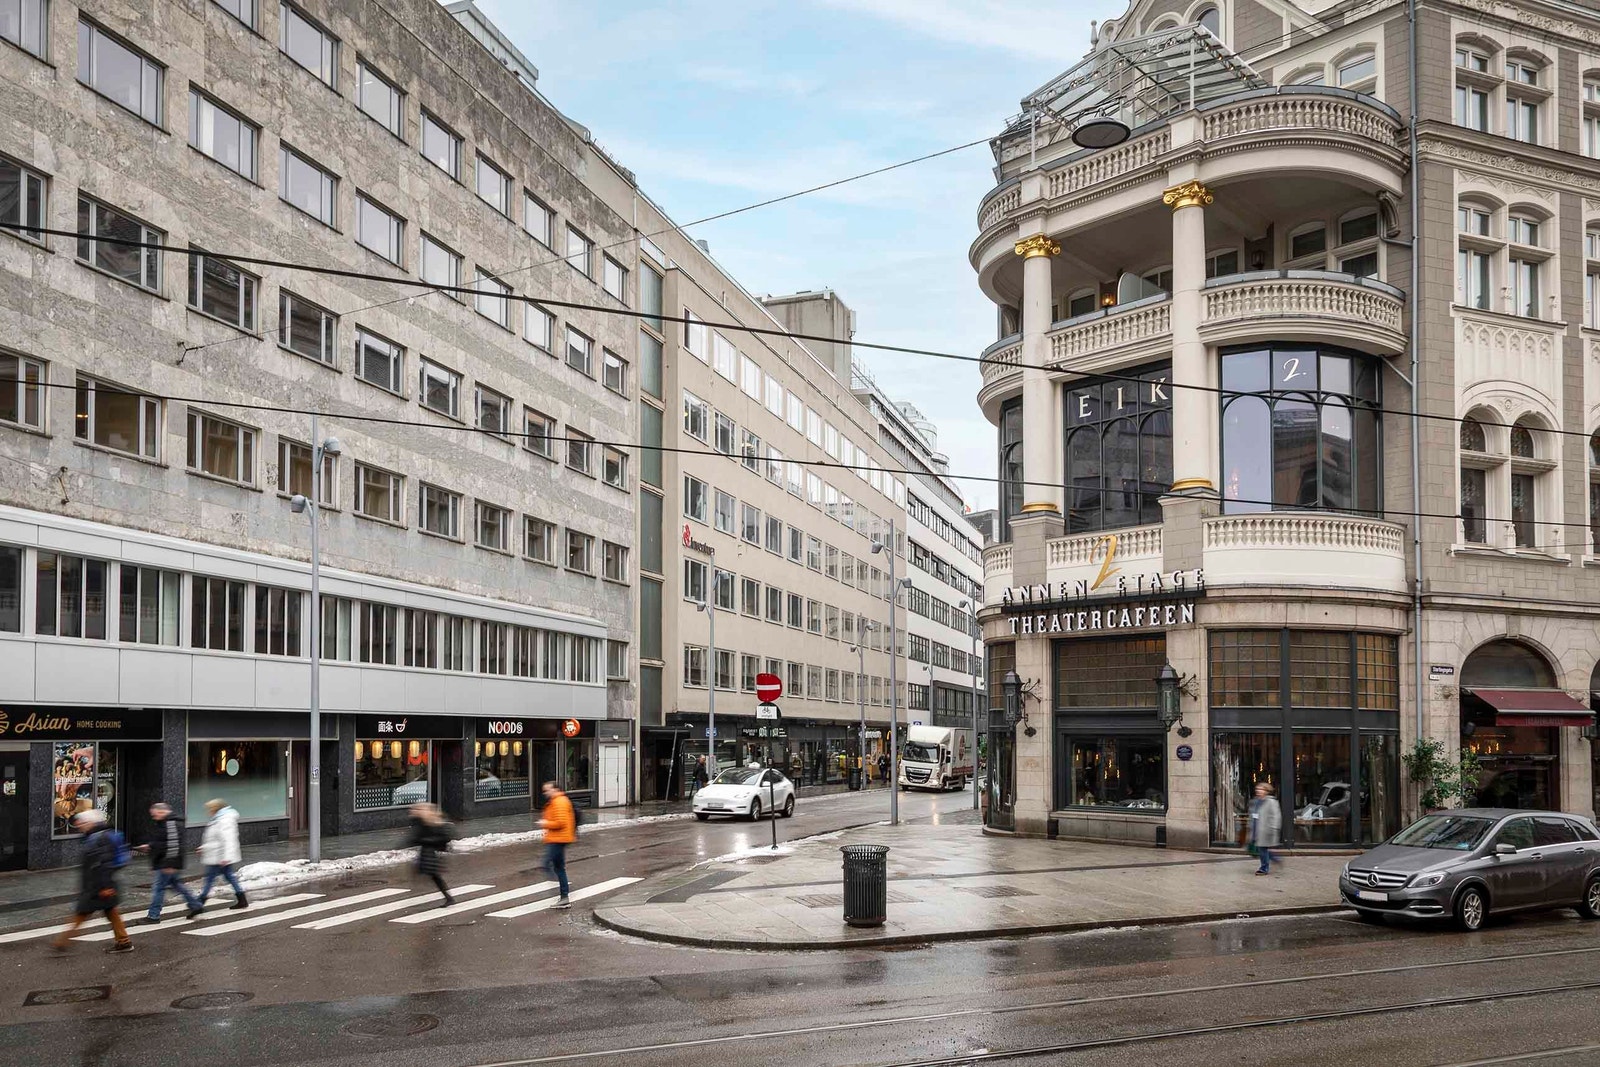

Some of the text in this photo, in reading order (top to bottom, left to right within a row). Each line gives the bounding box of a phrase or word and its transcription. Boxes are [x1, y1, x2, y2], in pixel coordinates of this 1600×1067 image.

[1002, 535, 1205, 600] ANNEN 2 ETAGE
[1008, 603, 1195, 635] THEATERCAFEEN
[14, 712, 122, 733] Asian HOME COOKING
[488, 721, 523, 734] NOODS
